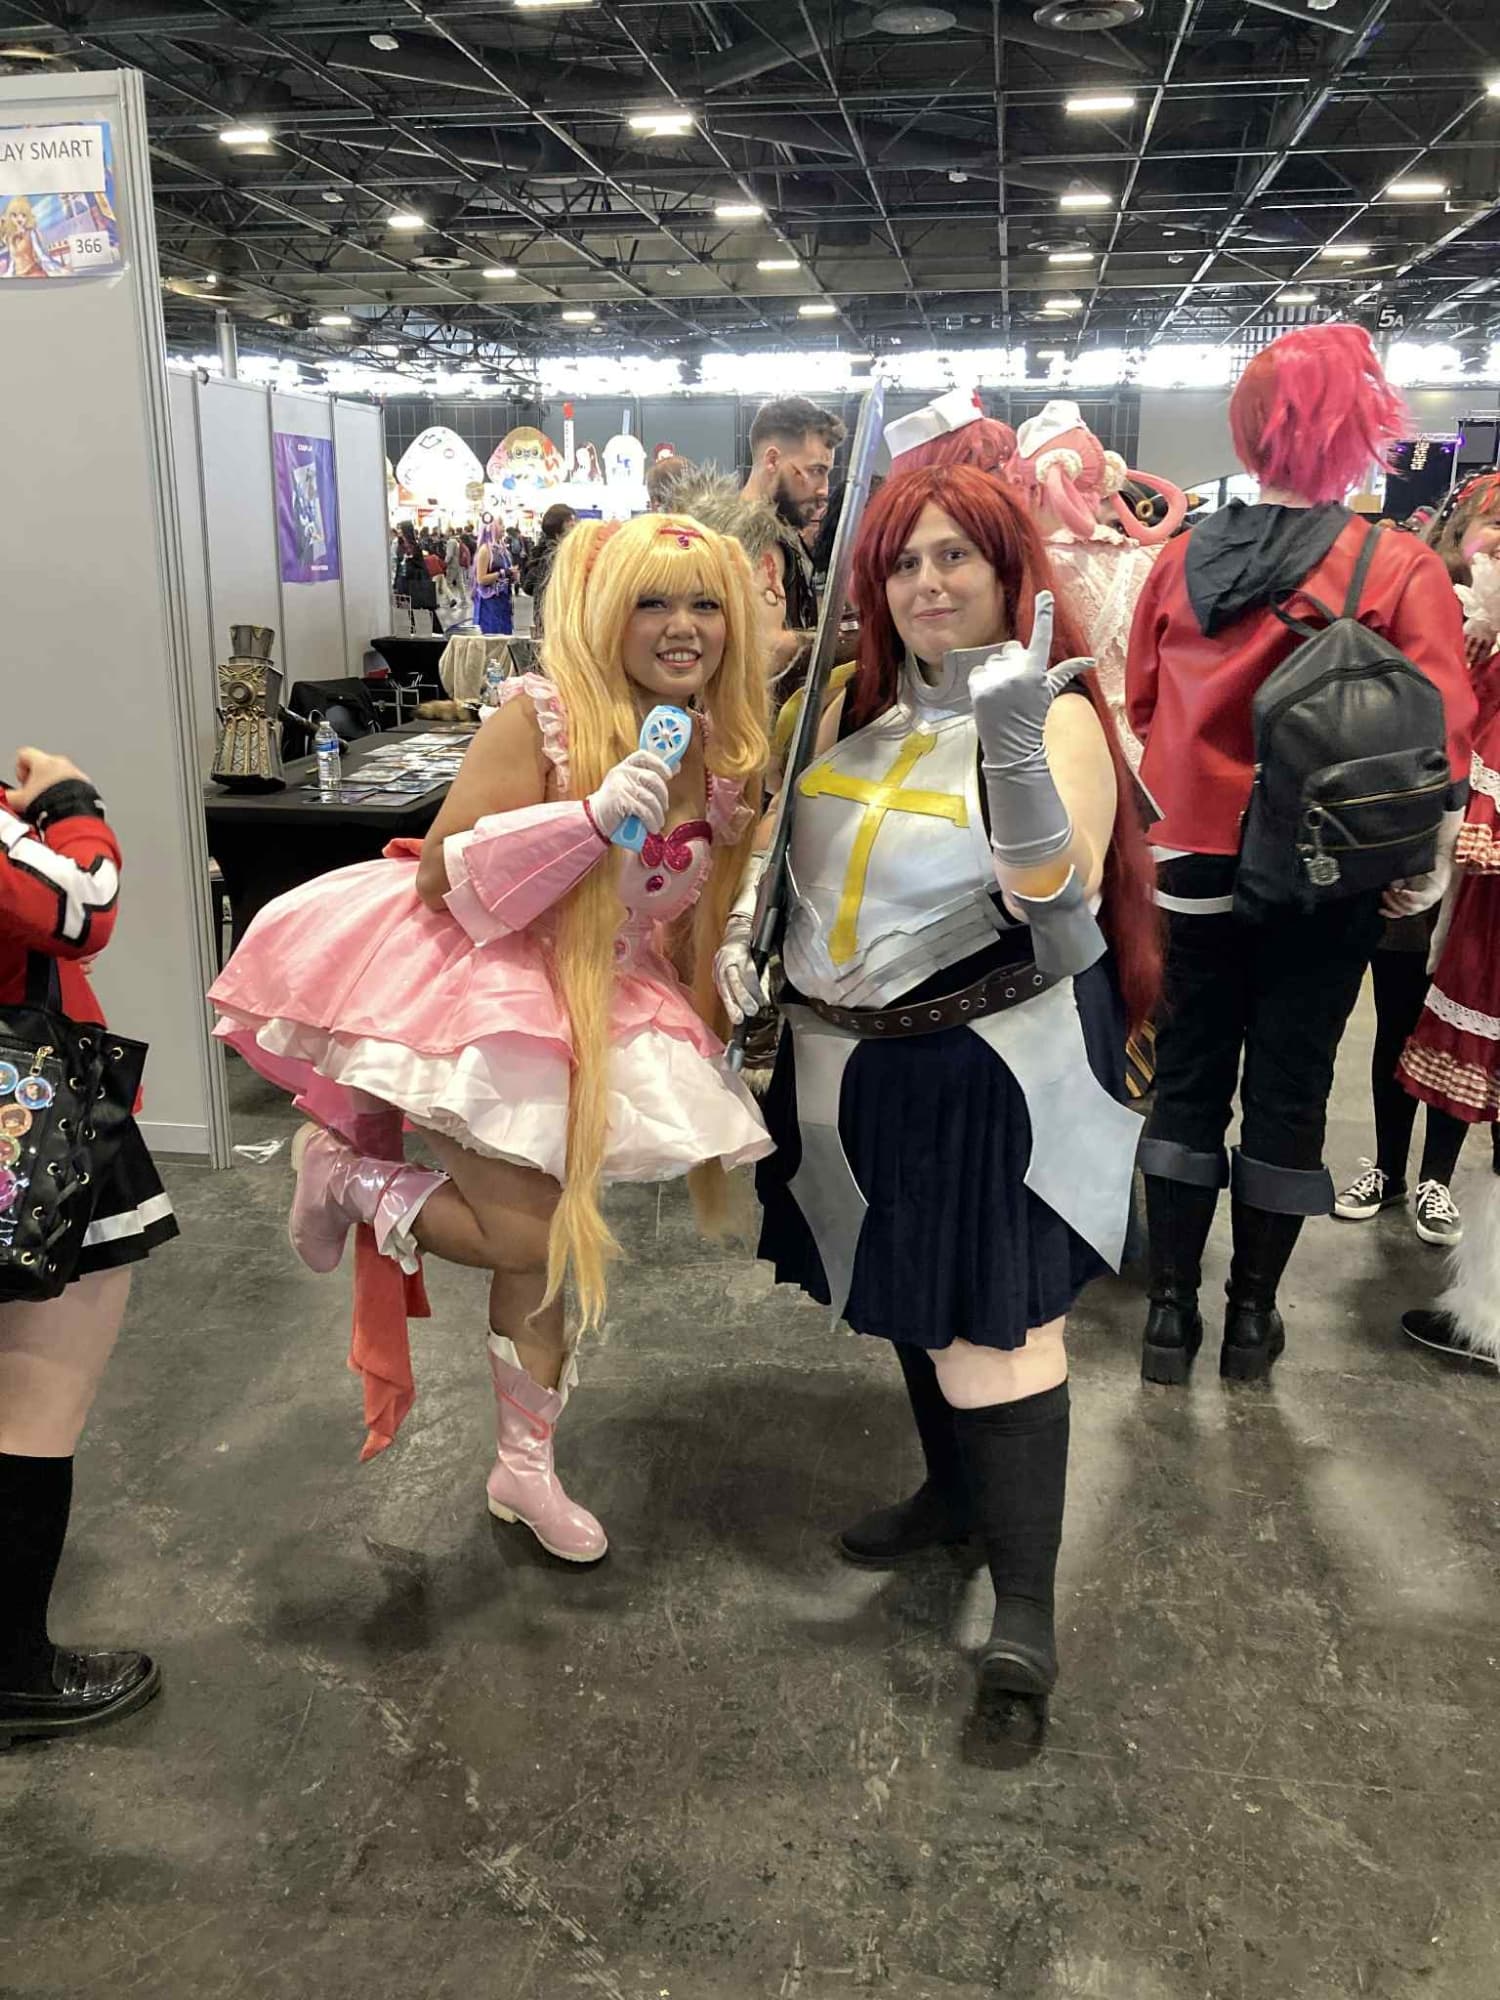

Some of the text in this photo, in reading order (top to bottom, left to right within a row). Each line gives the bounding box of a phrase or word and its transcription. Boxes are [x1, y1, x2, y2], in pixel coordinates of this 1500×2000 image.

[0, 140, 93, 162] AY SMART
[75, 238, 102, 254] 366
[1379, 309, 1405, 328] 5A
